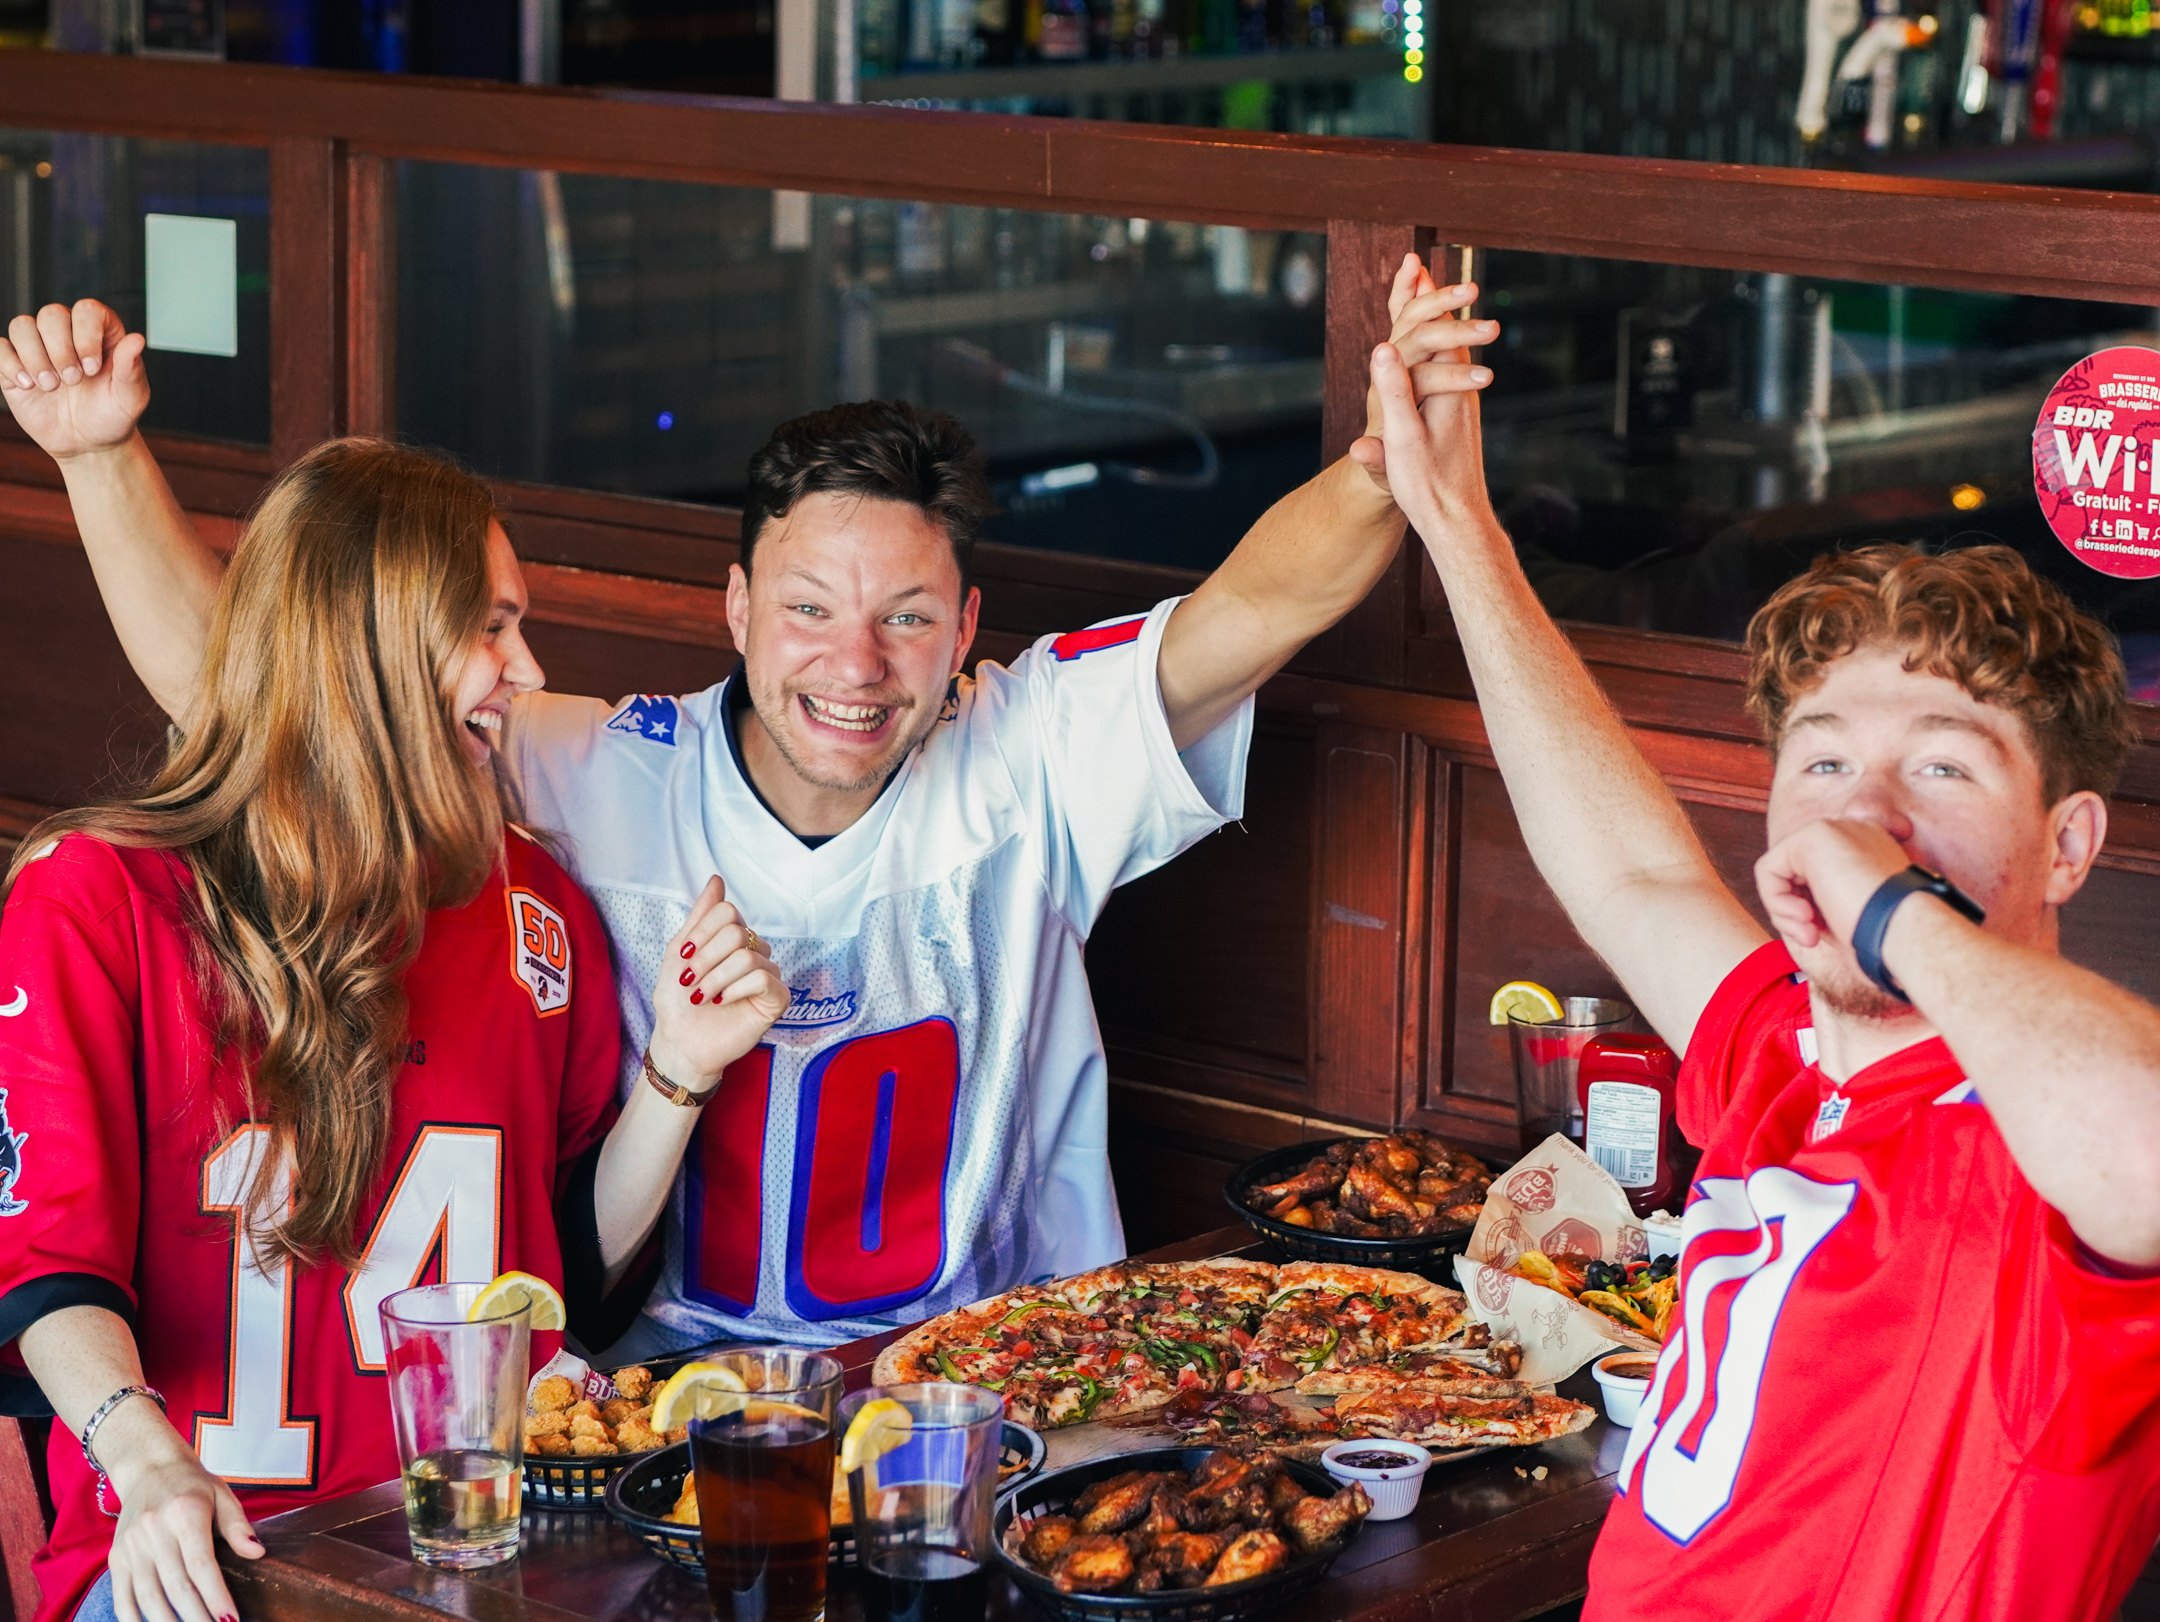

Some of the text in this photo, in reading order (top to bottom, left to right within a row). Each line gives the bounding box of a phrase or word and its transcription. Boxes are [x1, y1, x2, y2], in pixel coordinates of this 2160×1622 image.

[2053, 405, 2114, 430] BDR
[2072, 490, 2132, 512] Gratuit
[520, 901, 567, 972] 50
[683, 1016, 959, 1320] 10
[1554, 1136, 1575, 1155] Thank
[1573, 1151, 1588, 1165] you
[1586, 1161, 1599, 1173] for
[1596, 1168, 1607, 1178] 35
[1512, 1174, 1547, 1204] BDR
[193, 1119, 505, 1491] 14
[1482, 1268, 1504, 1307] BDR
[542, 1366, 554, 1376] 35
